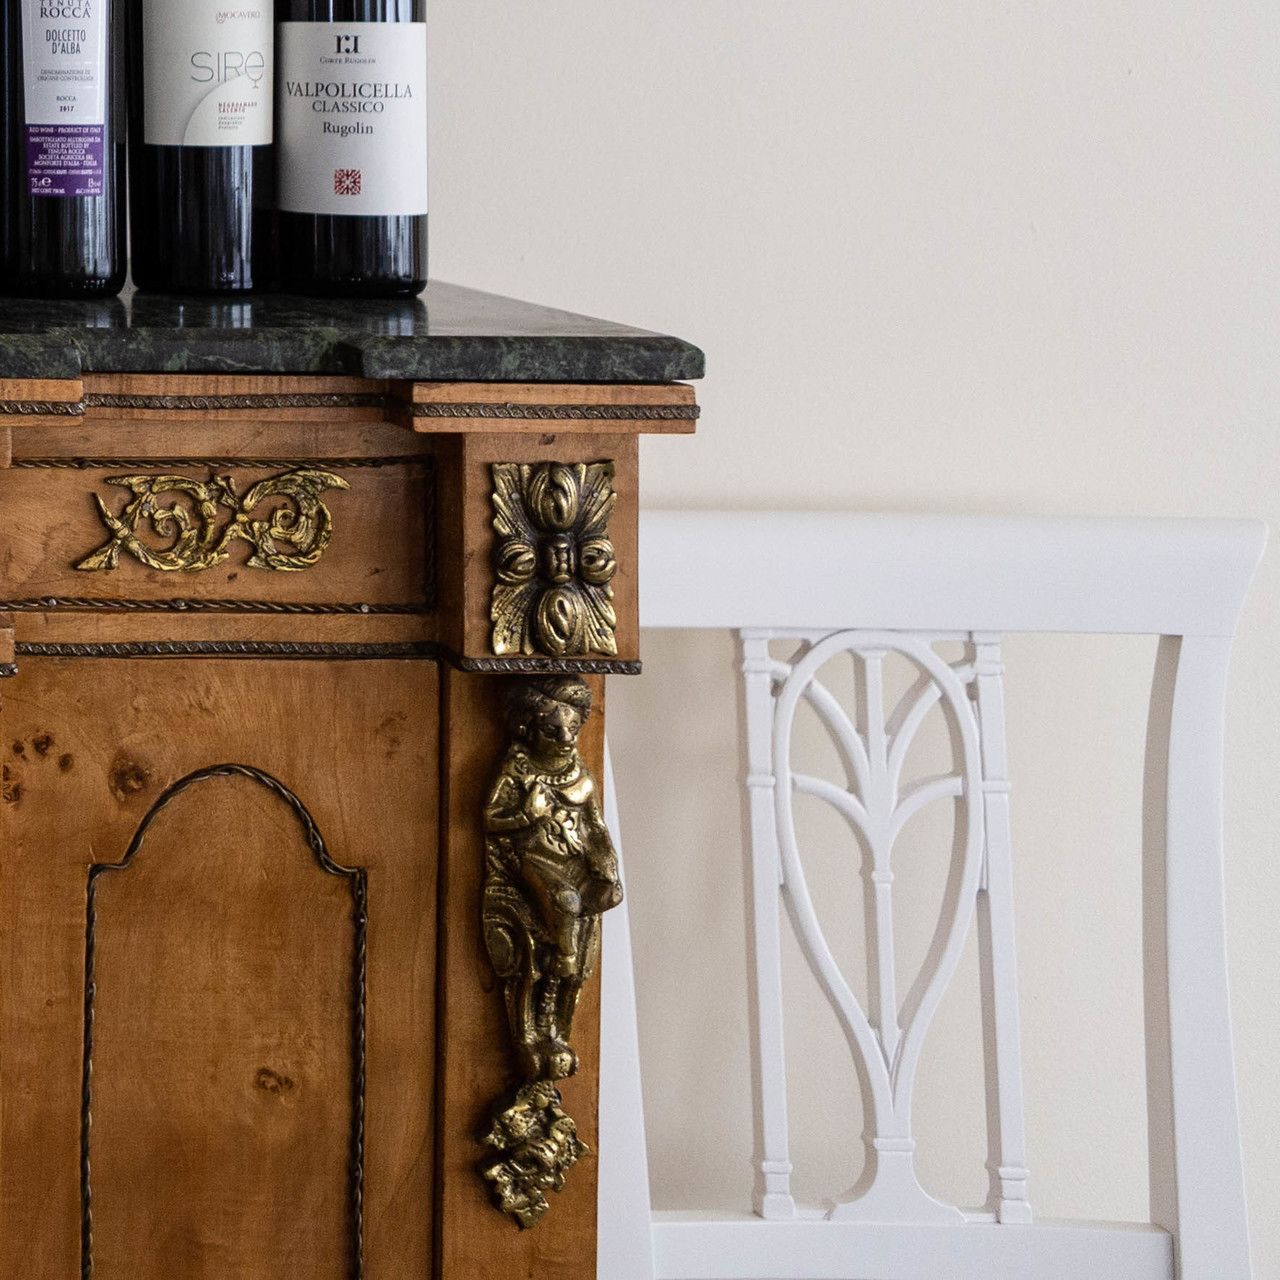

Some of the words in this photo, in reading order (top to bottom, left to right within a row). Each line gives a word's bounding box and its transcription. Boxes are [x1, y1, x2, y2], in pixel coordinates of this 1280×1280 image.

[40, 7, 91, 18] ROCCA
[45, 29, 86, 42] DOLCETTO
[52, 42, 81, 54] D'ALBA
[286, 81, 413, 98] VALPOLICELLA
[312, 100, 384, 113] CLASSICO
[323, 122, 374, 137] Rugolin
